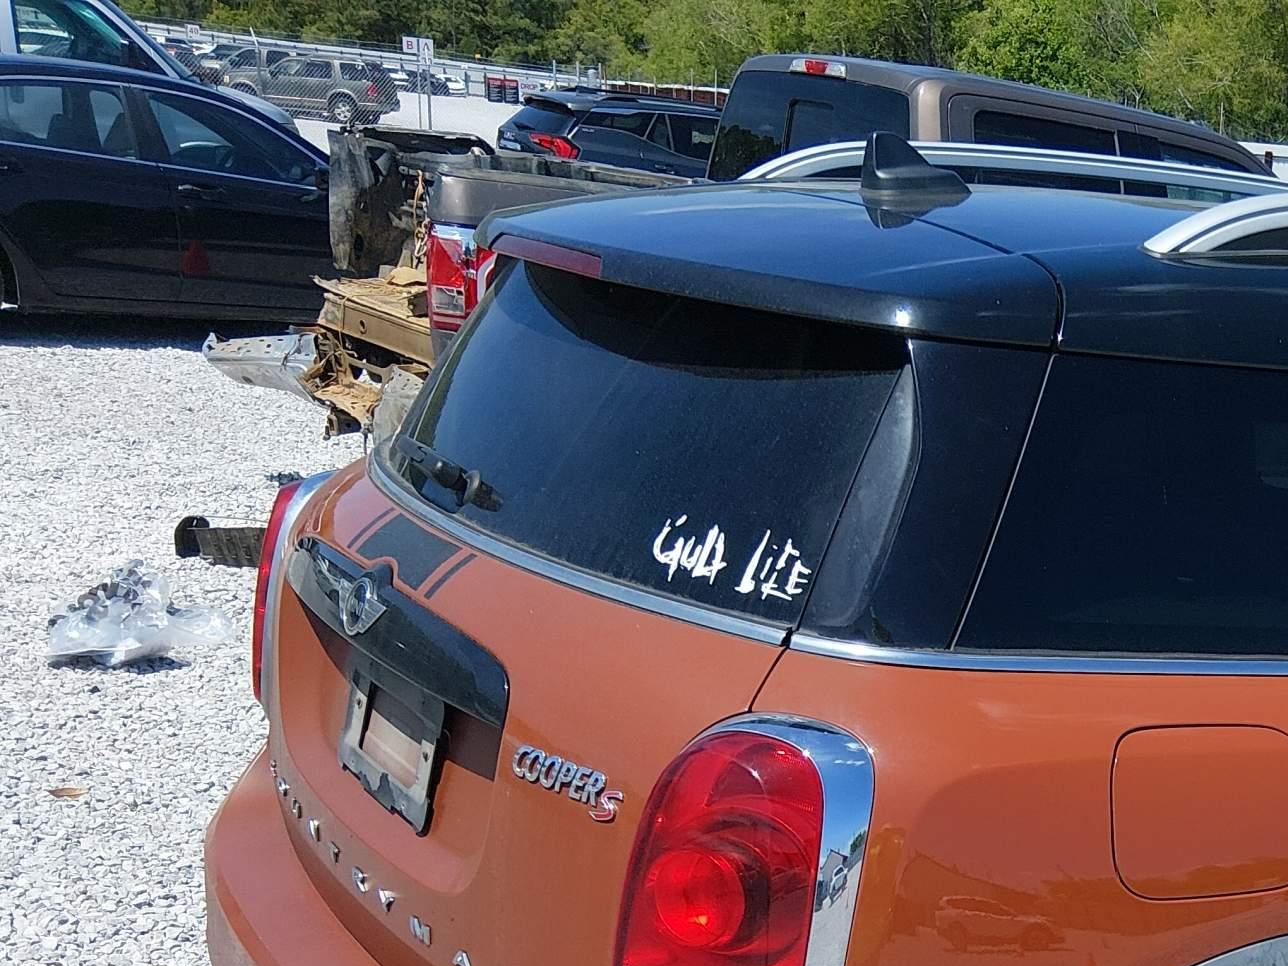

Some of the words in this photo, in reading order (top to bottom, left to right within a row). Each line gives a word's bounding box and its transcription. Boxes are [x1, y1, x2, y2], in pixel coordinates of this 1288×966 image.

[406, 41, 413, 49] B
[521, 83, 538, 91] DROP
[512, 745, 607, 807] COOPER
[588, 790, 624, 821] S
